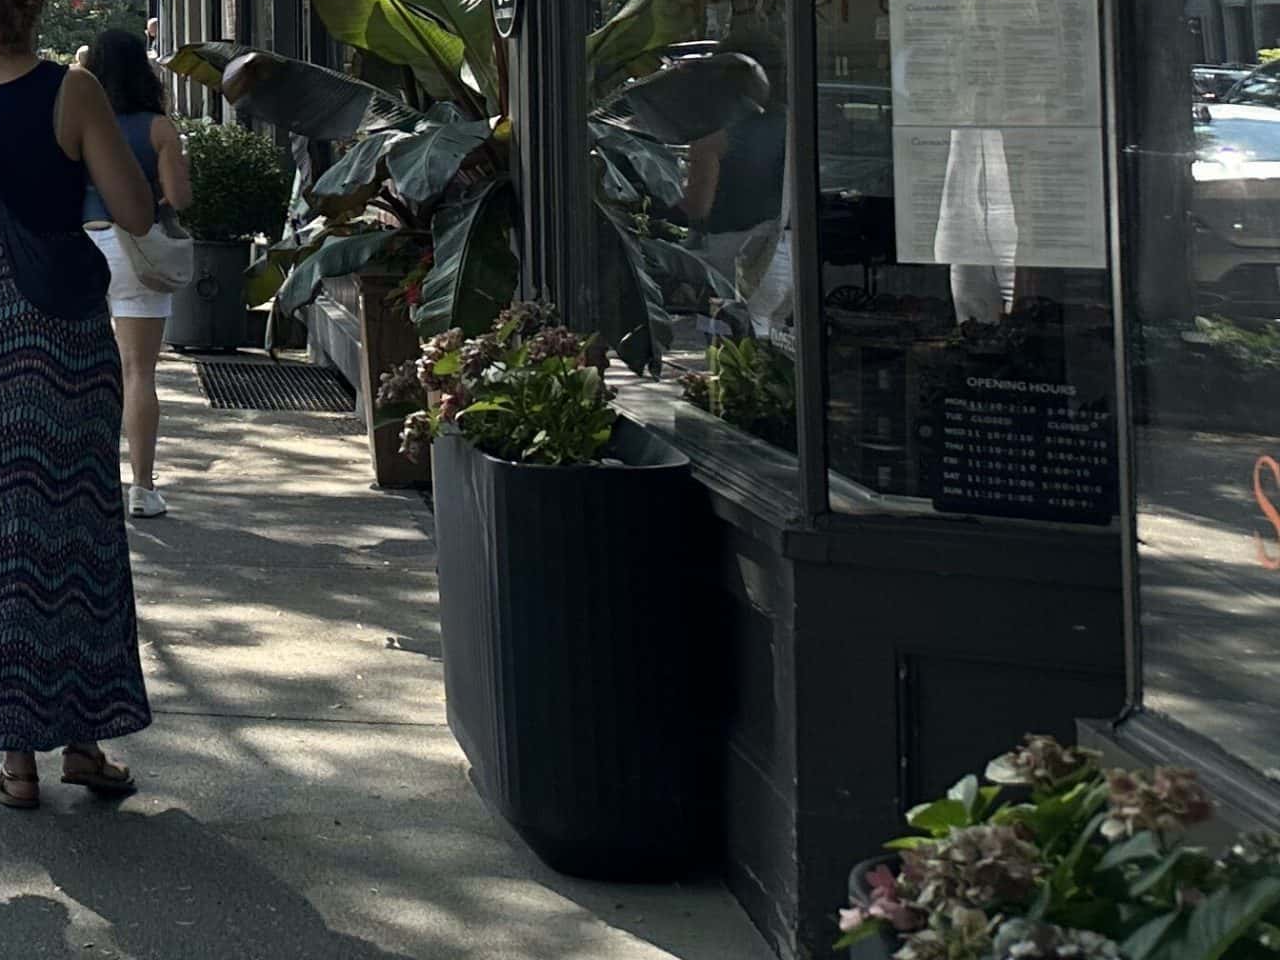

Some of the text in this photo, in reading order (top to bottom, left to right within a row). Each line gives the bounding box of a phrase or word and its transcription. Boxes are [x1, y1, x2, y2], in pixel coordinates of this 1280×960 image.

[966, 376, 1077, 396] OPENING HOURS
[943, 471, 960, 480] SAT
